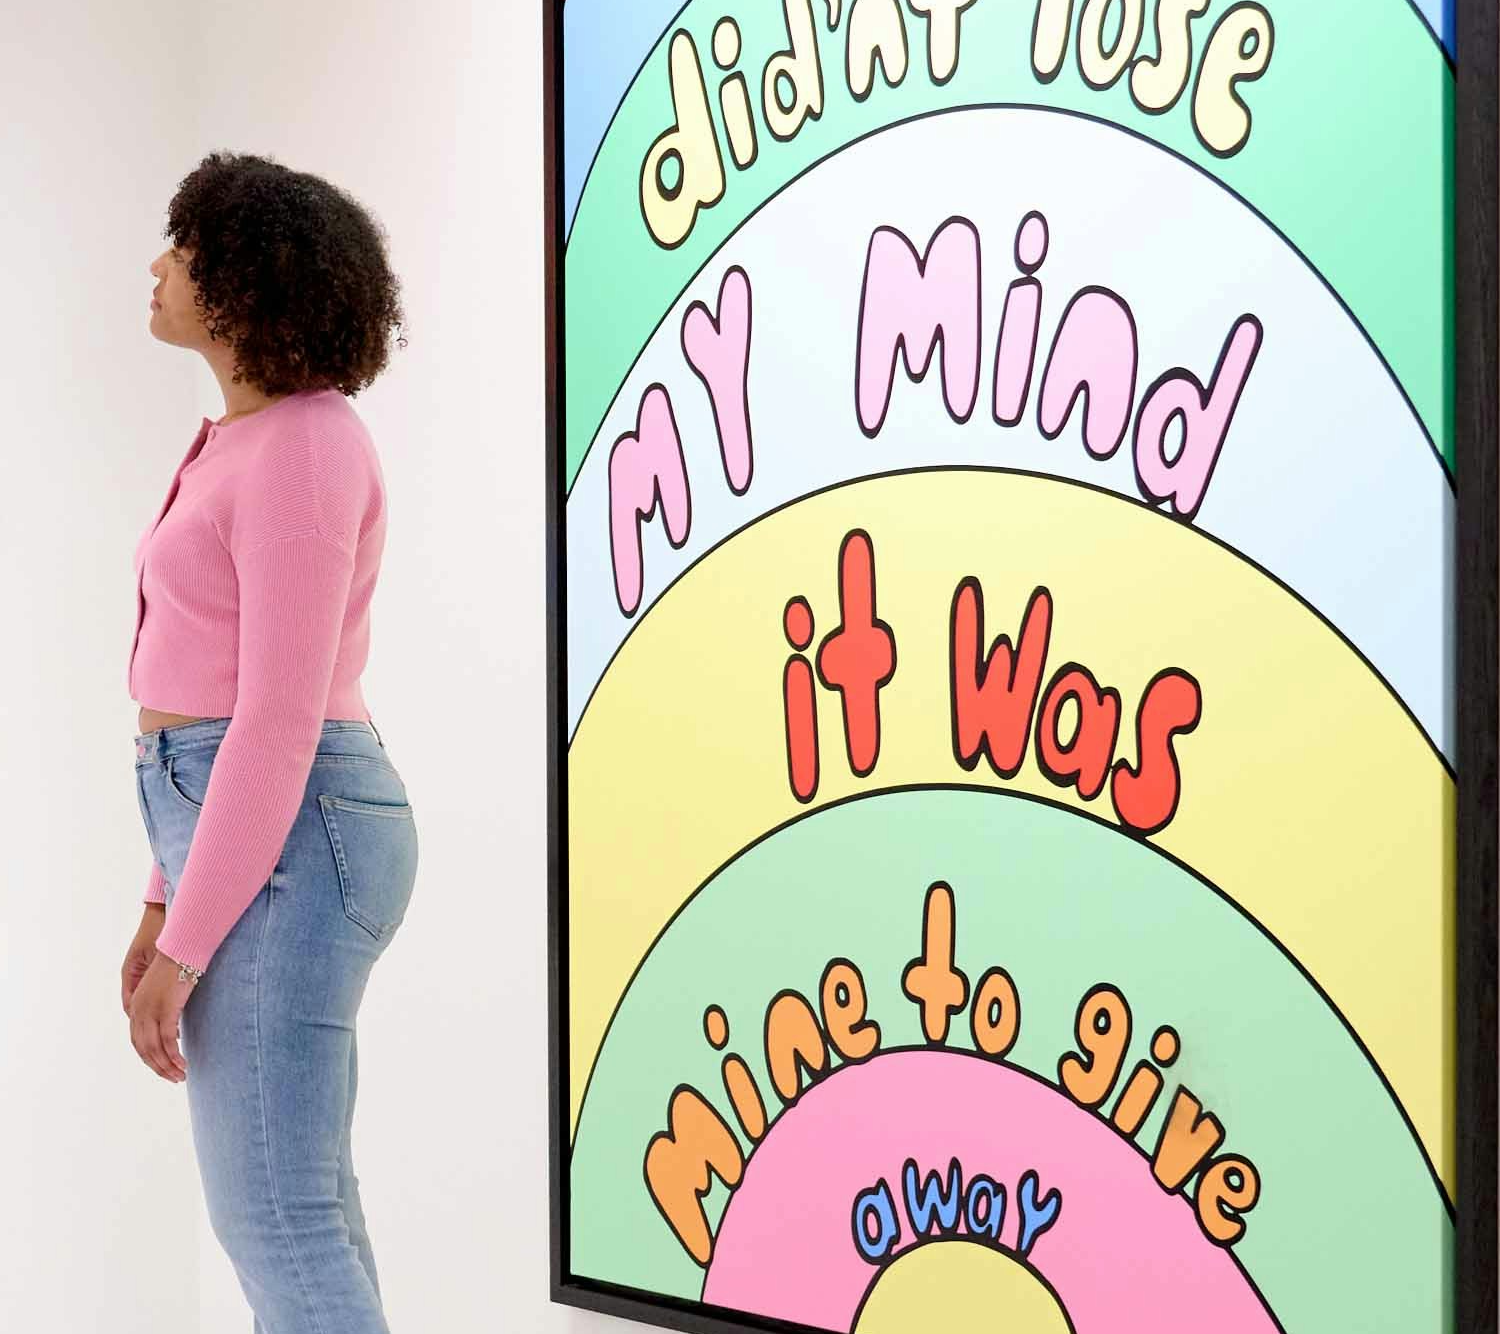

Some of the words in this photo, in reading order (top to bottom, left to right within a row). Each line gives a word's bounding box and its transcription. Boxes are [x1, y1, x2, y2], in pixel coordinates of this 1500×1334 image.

[608, 265, 754, 619] MY
[853, 210, 1265, 525] Mind
[782, 528, 897, 805] it
[949, 575, 1202, 838] Was
[643, 956, 882, 1269] Mine
[901, 881, 1021, 1057] to
[1057, 983, 1262, 1247] give
[852, 1156, 1063, 1266] away
